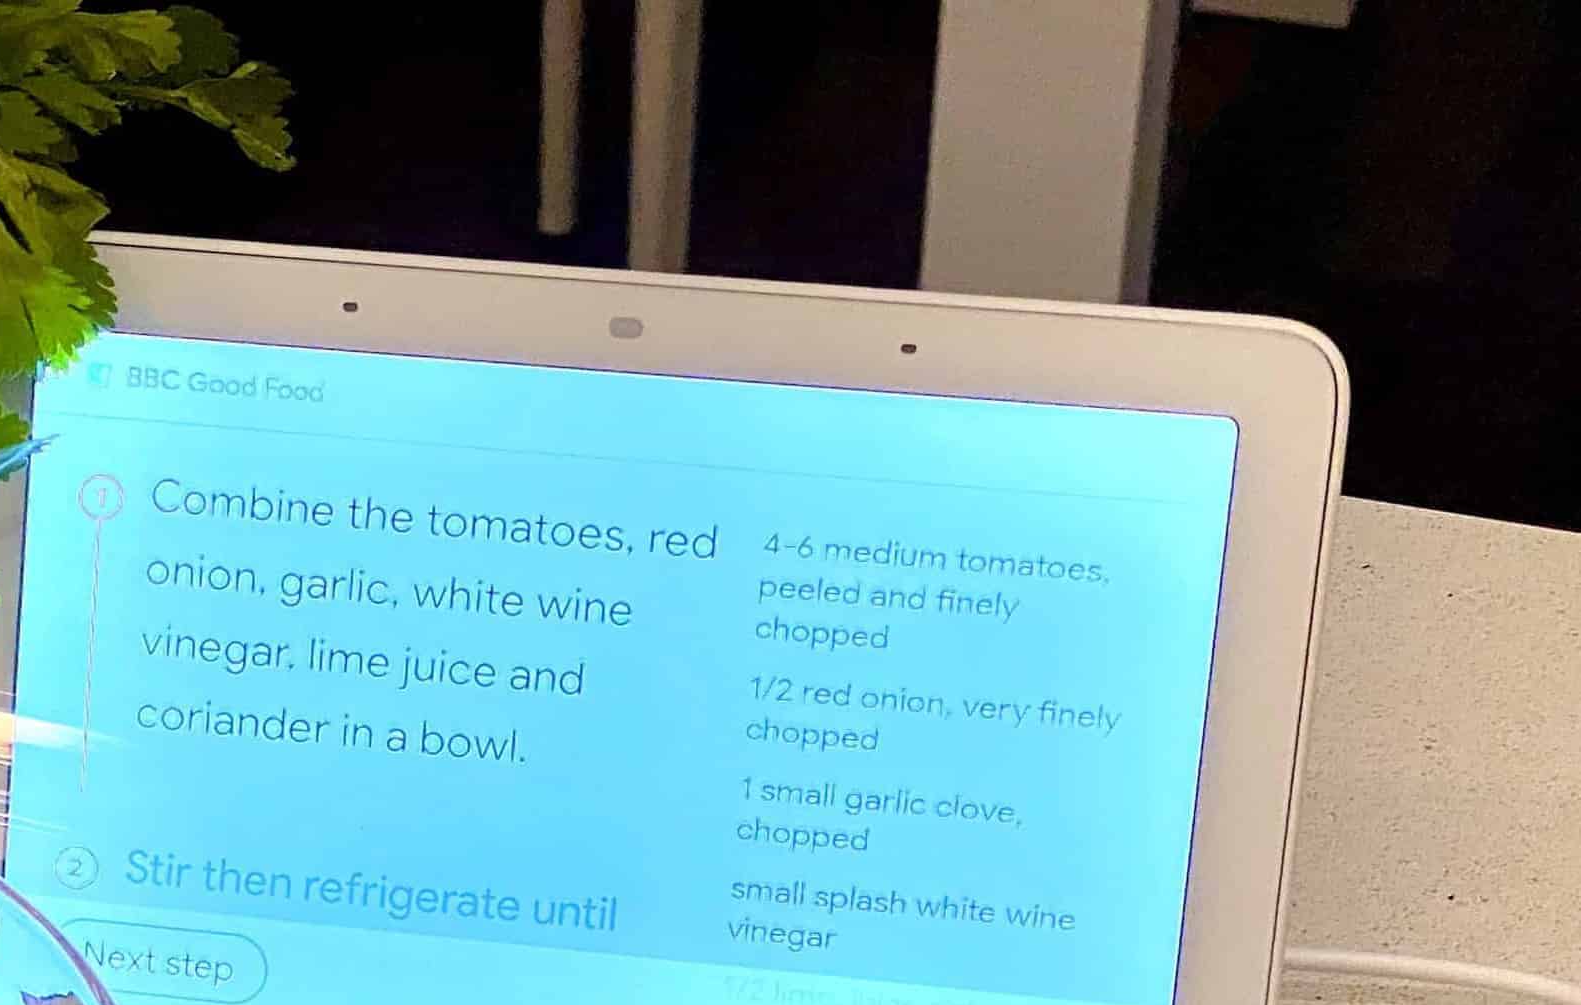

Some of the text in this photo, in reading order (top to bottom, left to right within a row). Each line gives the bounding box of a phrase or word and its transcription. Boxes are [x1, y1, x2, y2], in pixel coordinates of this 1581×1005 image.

[126, 365, 325, 403] BBC Good Food
[151, 477, 718, 561] Combine the tomatoes, red
[763, 533, 1111, 586] 4-6 medium tomatoes,
[147, 556, 632, 627] onion, garlic, white wine
[758, 576, 1019, 623] peeled and finely
[755, 617, 890, 652] chopped
[142, 625, 584, 696] vinegar, lime juice and
[751, 675, 1122, 737] 1/2 red onion, very finely
[137, 700, 527, 766] coriander in a bowl.
[746, 718, 880, 752] chopped
[742, 777, 1023, 827] 1 small garlic clove,
[736, 819, 870, 853] chopped
[126, 849, 192, 891] Stir
[204, 859, 291, 901] then
[304, 870, 520, 922] refrigerate
[534, 895, 618, 932] until
[731, 878, 1076, 933] small splash white wine
[728, 917, 838, 952] vinegar
[84, 940, 235, 986] Next step
